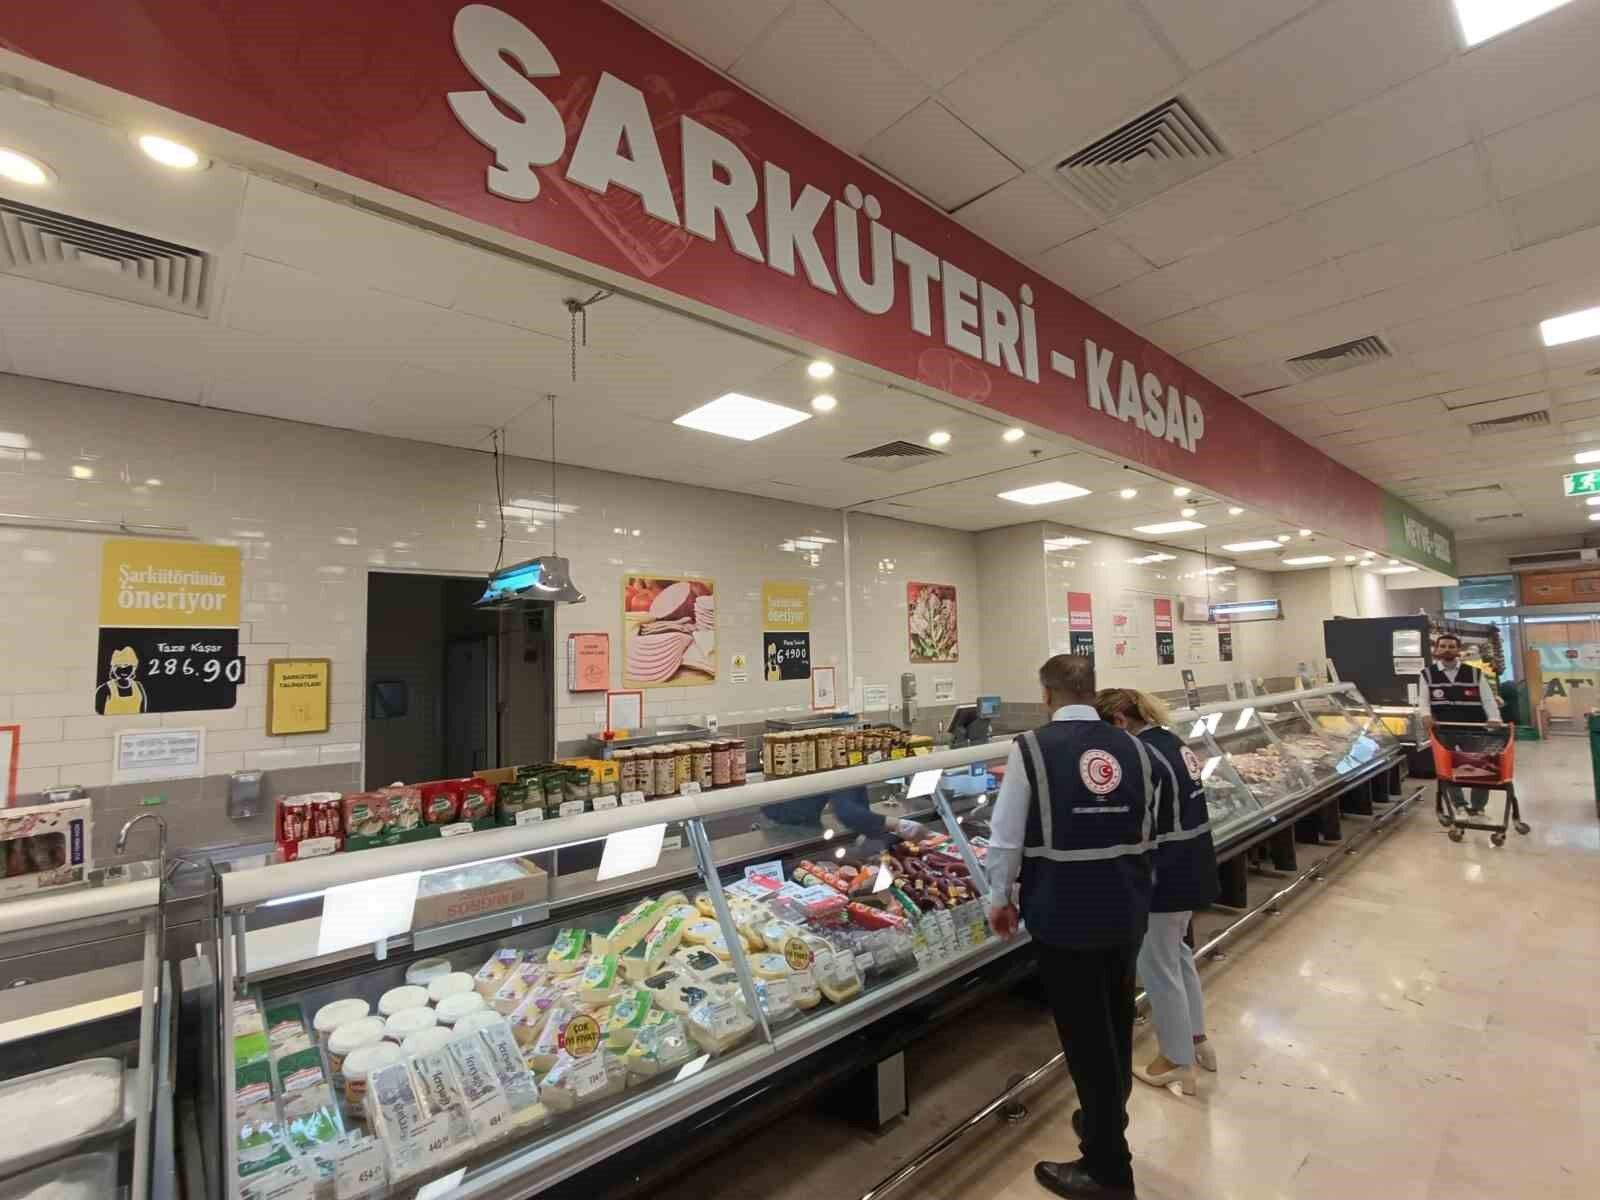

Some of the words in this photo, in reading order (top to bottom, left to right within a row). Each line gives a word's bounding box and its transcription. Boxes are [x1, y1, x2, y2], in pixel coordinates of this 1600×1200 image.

[447, 3, 1040, 385] ŞARKÜTERİ
[1051, 349, 1076, 379] -
[1084, 338, 1205, 453] KASAP
[117, 585, 227, 615] öneriyor
[157, 642, 186, 653] Taze
[148, 657, 242, 682] 286.90
